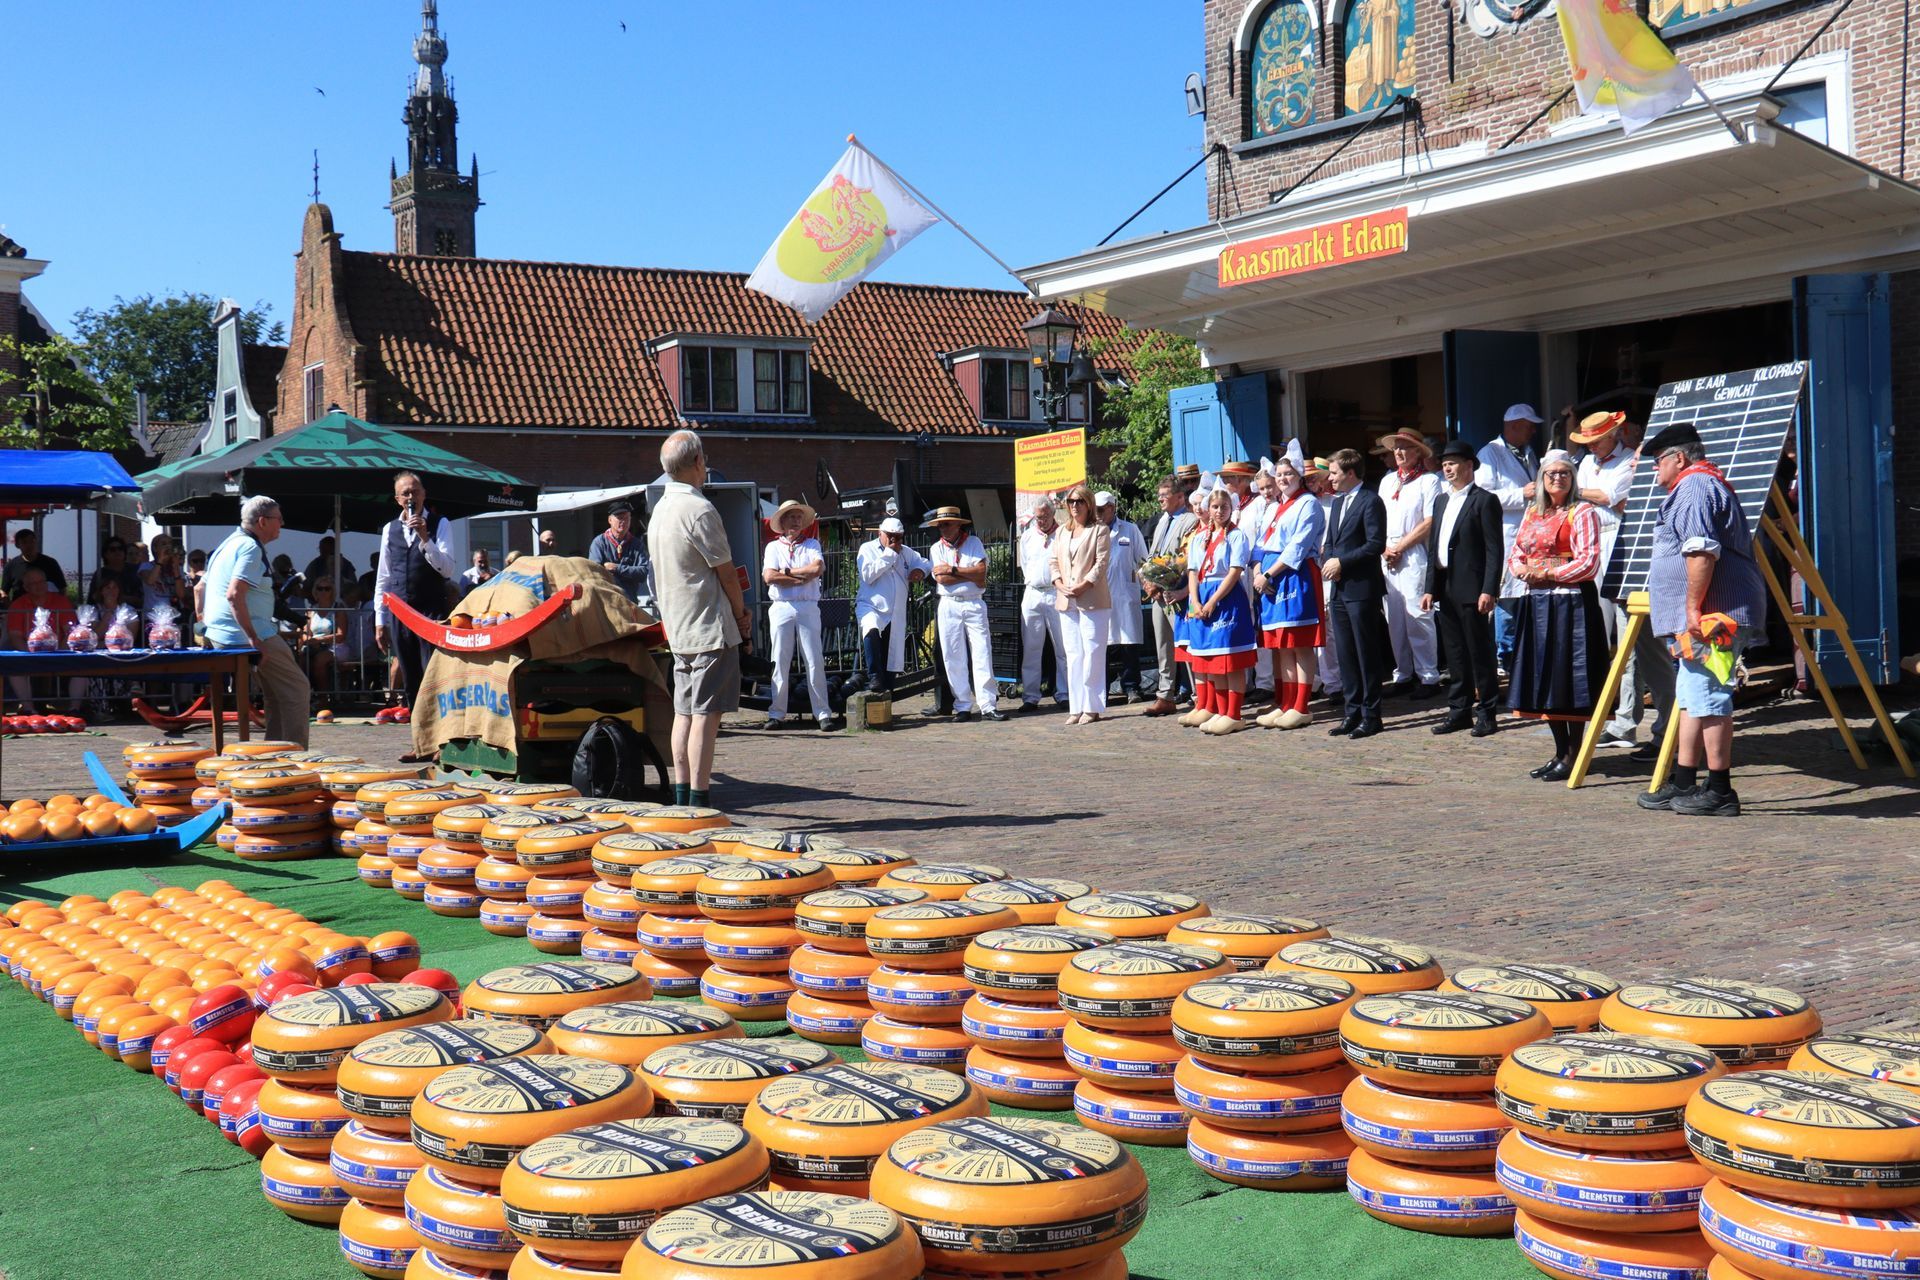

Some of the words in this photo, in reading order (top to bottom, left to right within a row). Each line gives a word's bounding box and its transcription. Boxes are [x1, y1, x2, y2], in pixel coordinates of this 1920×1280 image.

[1268, 63, 1301, 79] HANDEL
[1221, 229, 1335, 283] Kaasmarkt
[1343, 219, 1405, 258] Edam
[1753, 361, 1805, 382] KILOPRIJS
[1654, 396, 1677, 409] BOER
[1714, 383, 1758, 400] GEWICHT
[1061, 434, 1081, 445] Edam
[254, 451, 523, 485] Heineken
[487, 495, 524, 507] Heineken
[808, 922, 828, 931] BEEMSTER
[747, 948, 774, 956] BEEMSTER
[902, 941, 929, 949] BEEMSTER
[671, 978, 697, 986] BEEMSTER
[803, 975, 824, 985] BEEMSTER
[1008, 976, 1038, 985] BEEMSTER
[1228, 976, 1310, 992] BEEMSTER
[905, 992, 934, 1000] BEEMSTER
[1401, 993, 1484, 1011] BEEMSTER
[1077, 1001, 1102, 1011] BEEMSTER
[206, 1005, 236, 1022] BEEMSTER
[422, 1026, 469, 1048] BEEMSTER
[998, 1027, 1028, 1038] BEEMSTER
[1313, 1034, 1340, 1045] BEEMSTE
[705, 1041, 770, 1061] BEEMSTER
[916, 1049, 947, 1058] BEEMSTER
[1560, 1039, 1662, 1056] BEEMSTER
[1116, 1062, 1151, 1072] BEEMSTER
[1417, 1057, 1457, 1069] BEEMSTER
[501, 1061, 556, 1092] BEEMSTER
[827, 1069, 902, 1100] BEEMSTER
[1032, 1080, 1064, 1091] BEEMSTER
[1761, 1077, 1872, 1107] BEEMSTER
[1226, 1101, 1262, 1112] BEEMSTER
[1128, 1111, 1162, 1122] BEEMSTER
[1612, 1118, 1654, 1128] BEEMER
[268, 1118, 295, 1131] BEEMSTER
[1354, 1119, 1381, 1136] BEEMSTER
[592, 1129, 672, 1153] BEEMSTER
[961, 1124, 1049, 1157] BEEMSTER
[1434, 1133, 1475, 1143] BEEMSTER
[798, 1160, 841, 1173] BEEMSTER
[1733, 1150, 1776, 1169] BEEMSTER
[1502, 1166, 1526, 1185] BEEMSTER
[1853, 1168, 1901, 1179] BEEMSTER
[276, 1183, 303, 1196] BEEMSTER
[1578, 1189, 1625, 1204] BEEMSTER
[1399, 1197, 1438, 1209] BEEMSTER
[518, 1214, 550, 1229] BEEMSTER
[618, 1217, 656, 1231] BEEMST
[726, 1204, 819, 1240] BEEMSTER
[437, 1223, 474, 1240] BEEMSTER
[922, 1225, 967, 1242] BEEMSTER
[1047, 1225, 1094, 1241] BEEMSTER
[1735, 1228, 1778, 1251] BEEMSTER
[349, 1244, 375, 1259] BEEMSTER
[1531, 1242, 1564, 1262] BEEMSTER
[1853, 1256, 1906, 1270] BEEMSTER
[1622, 1266, 1669, 1280] BEEMSTER
